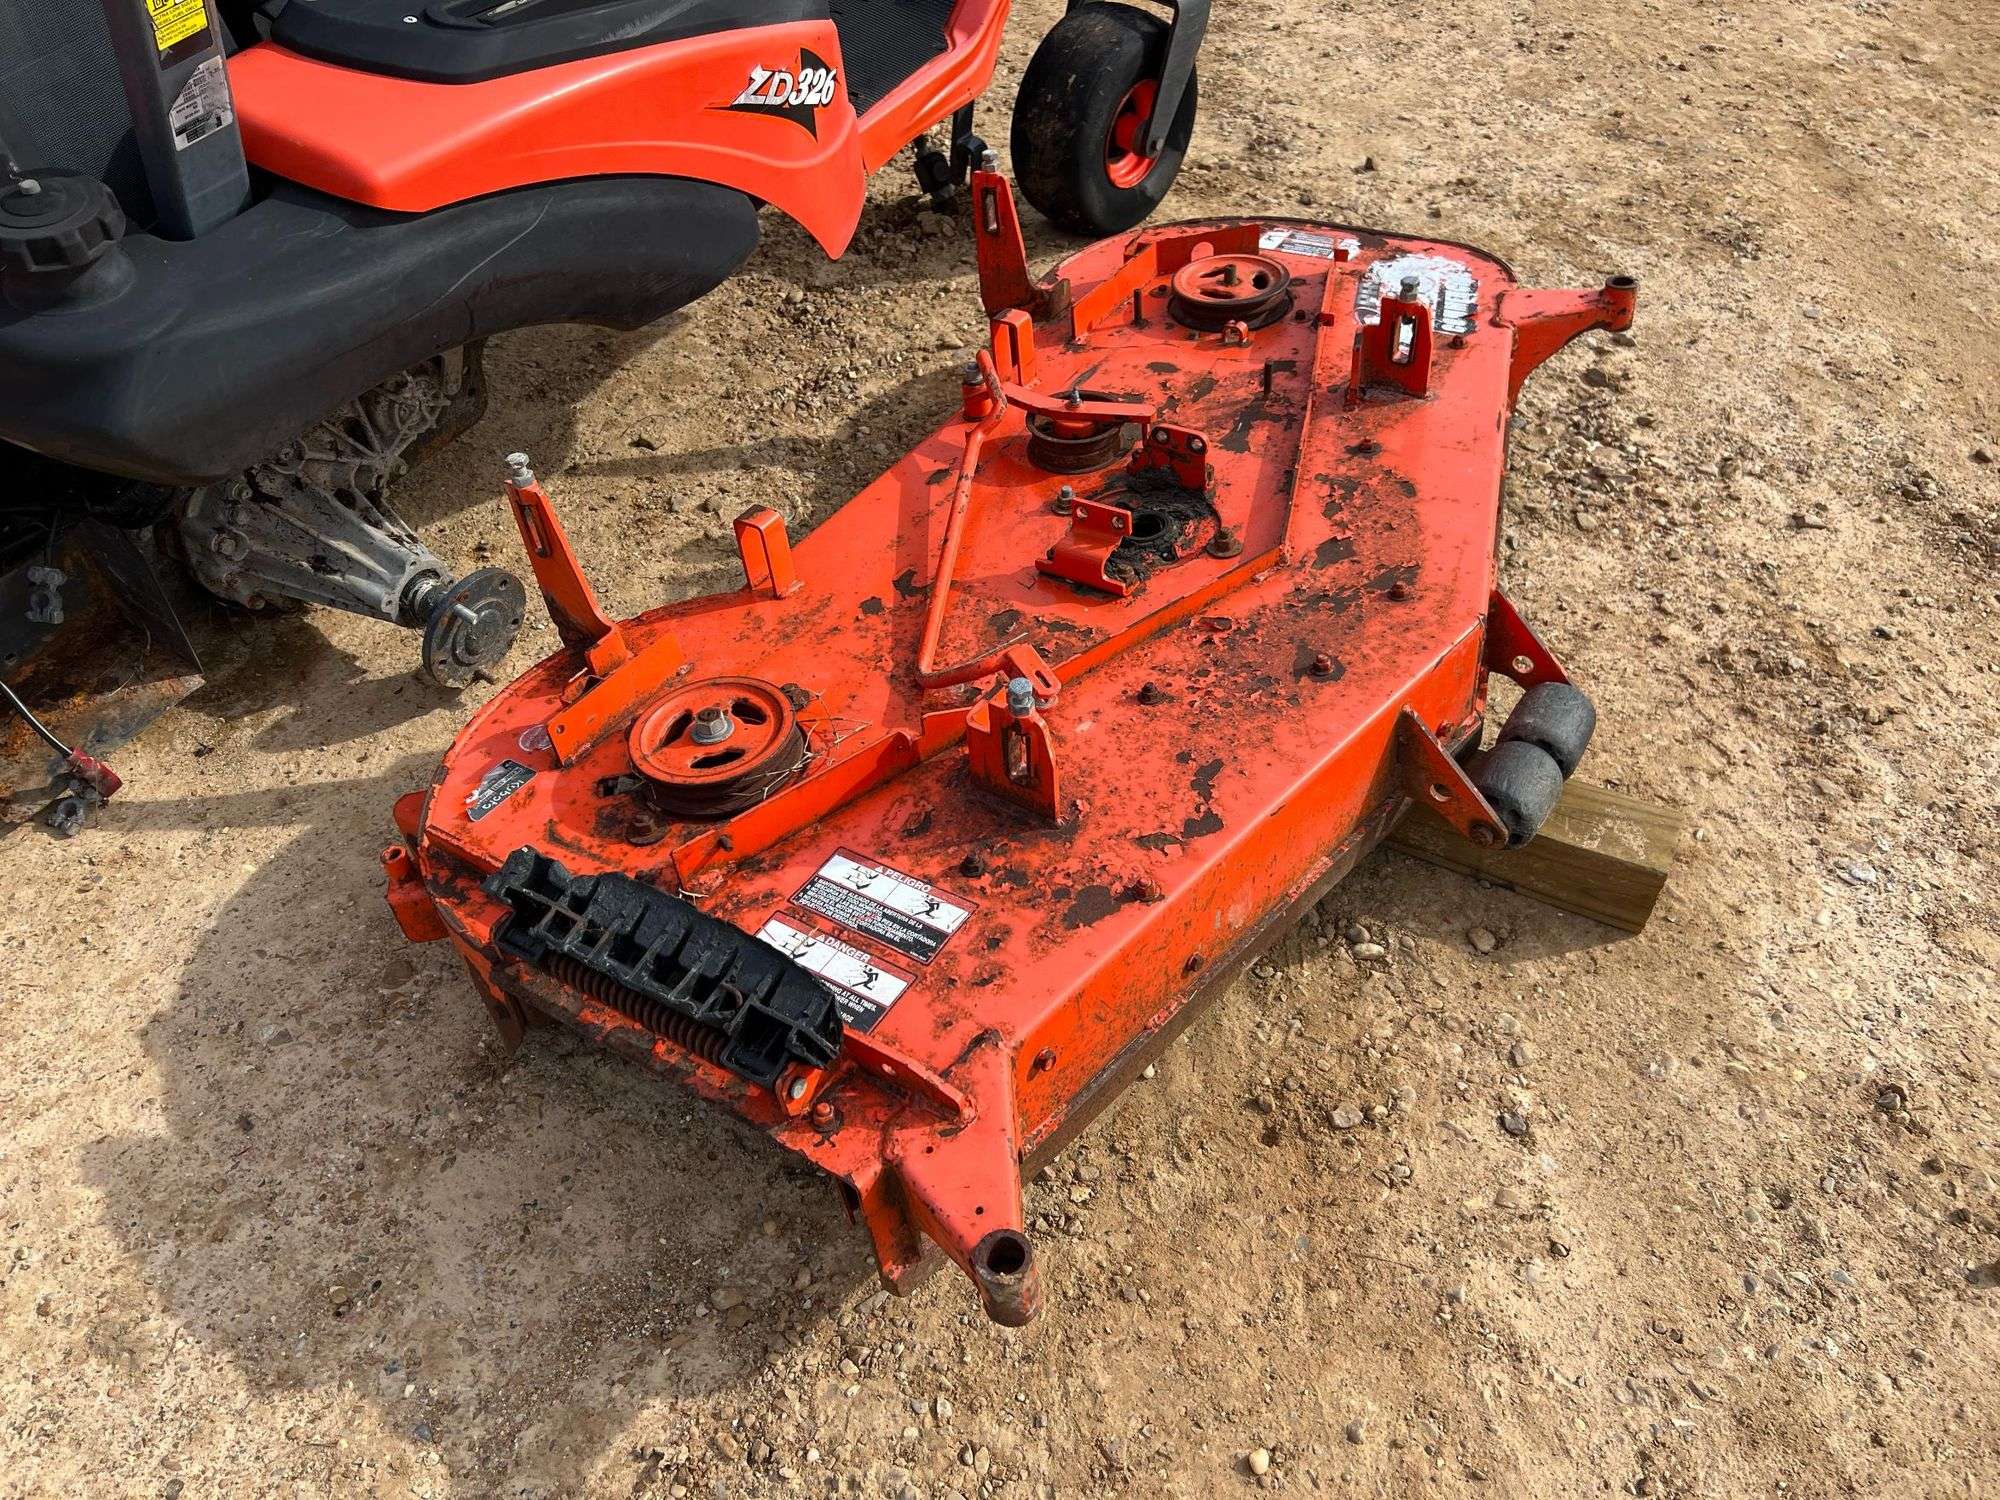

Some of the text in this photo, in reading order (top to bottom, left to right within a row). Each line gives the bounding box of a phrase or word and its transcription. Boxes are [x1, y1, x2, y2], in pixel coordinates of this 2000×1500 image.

[732, 64, 837, 105] ZD326
[885, 869, 933, 893] PELIGRO
[914, 921, 924, 929] LA
[905, 929, 938, 947] CORTADORA
[824, 937, 871, 963] DANGER
[840, 989, 851, 998] AT
[847, 993, 862, 1003] ALL
[846, 1000, 865, 1013] WHEN
